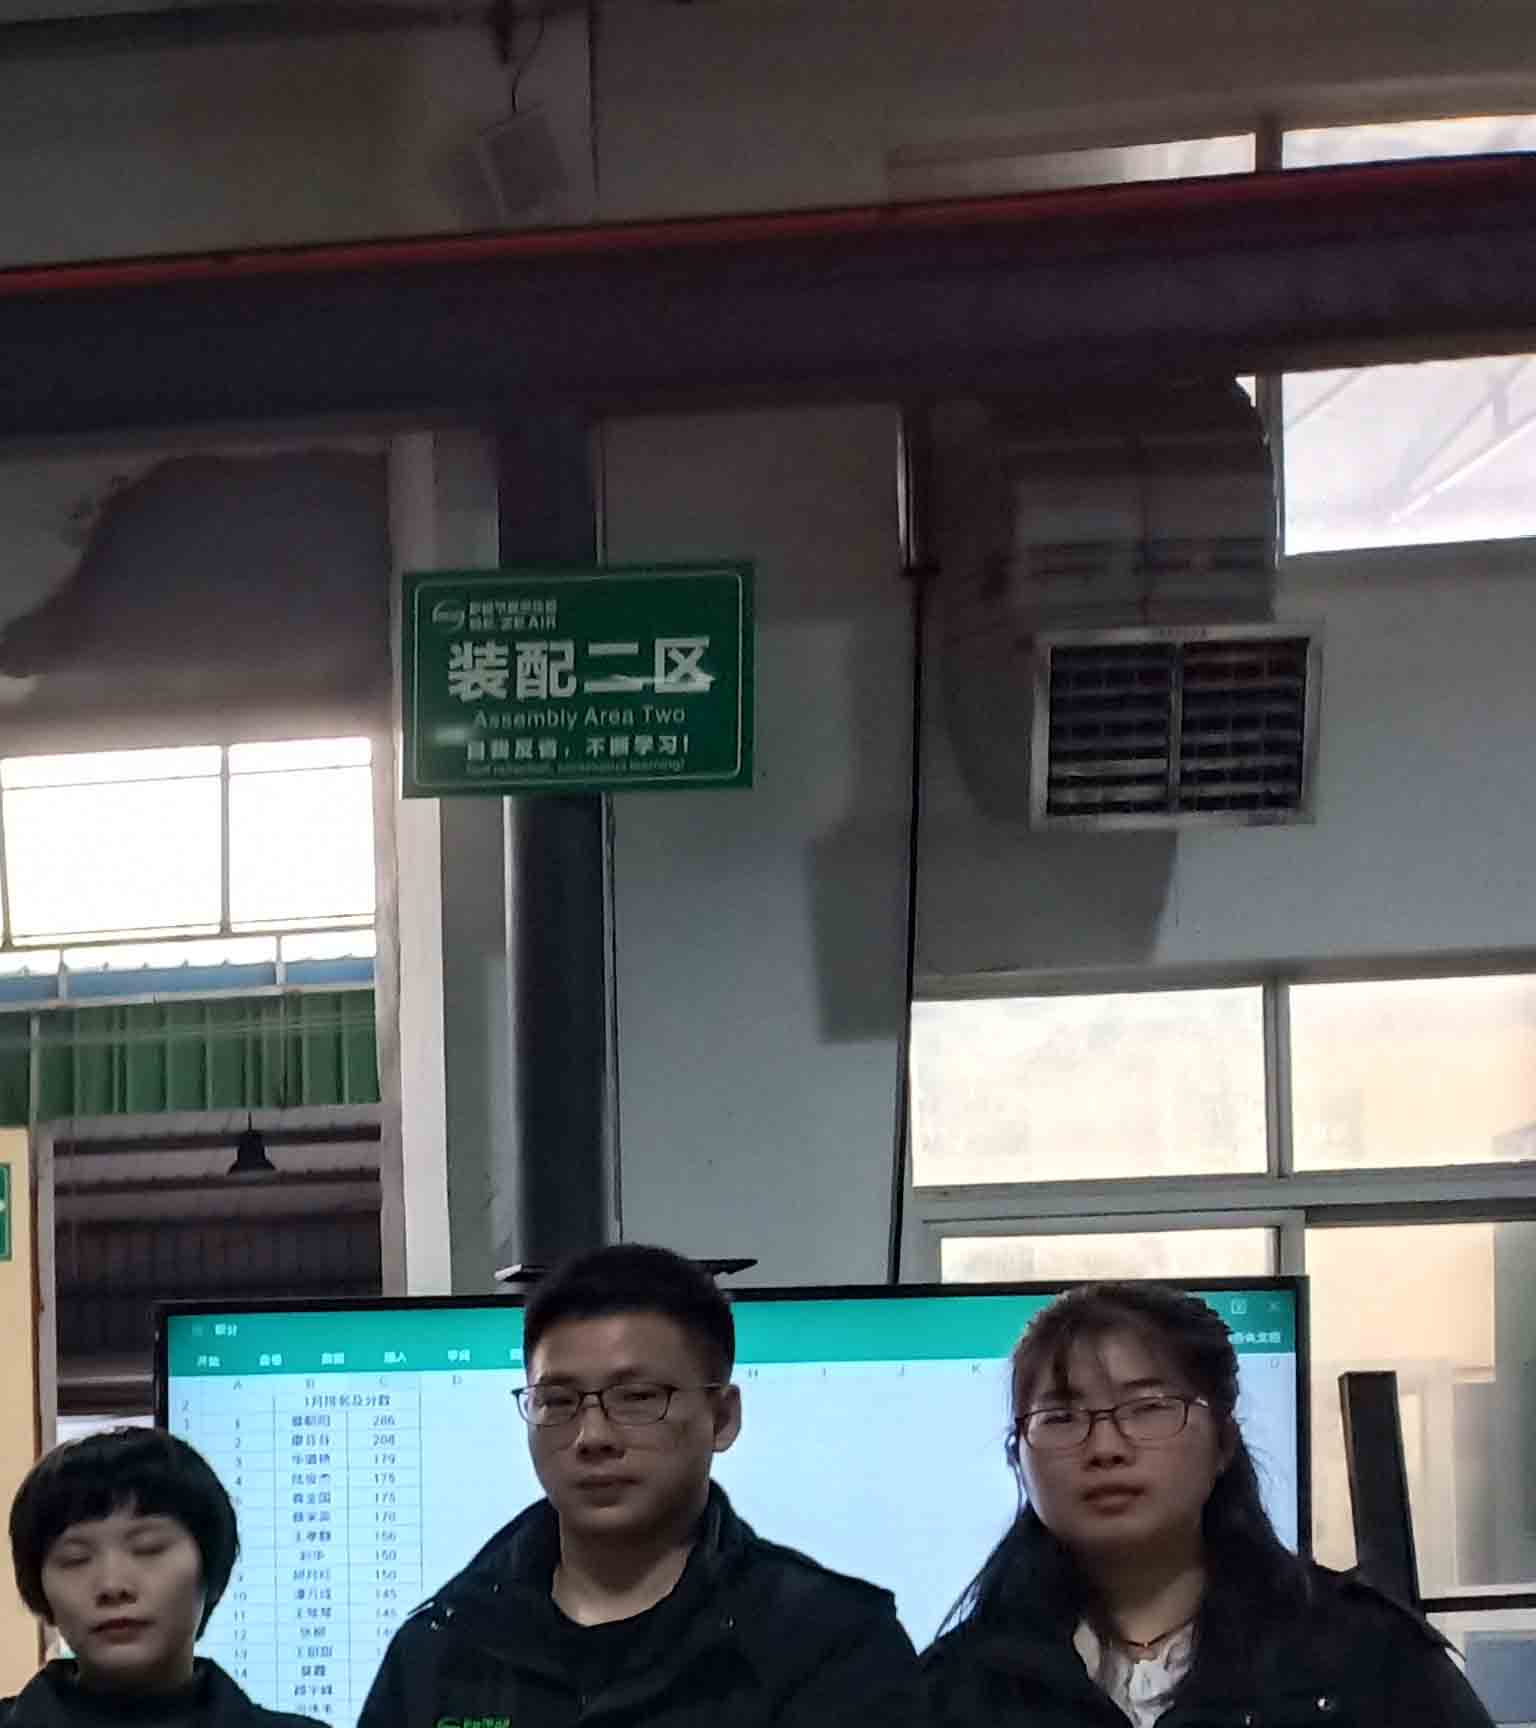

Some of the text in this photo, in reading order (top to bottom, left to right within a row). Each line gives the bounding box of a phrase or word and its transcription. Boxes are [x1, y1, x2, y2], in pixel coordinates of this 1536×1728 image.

[448, 637, 711, 702] 装配二区
[474, 704, 686, 731] Assembly Area Two
